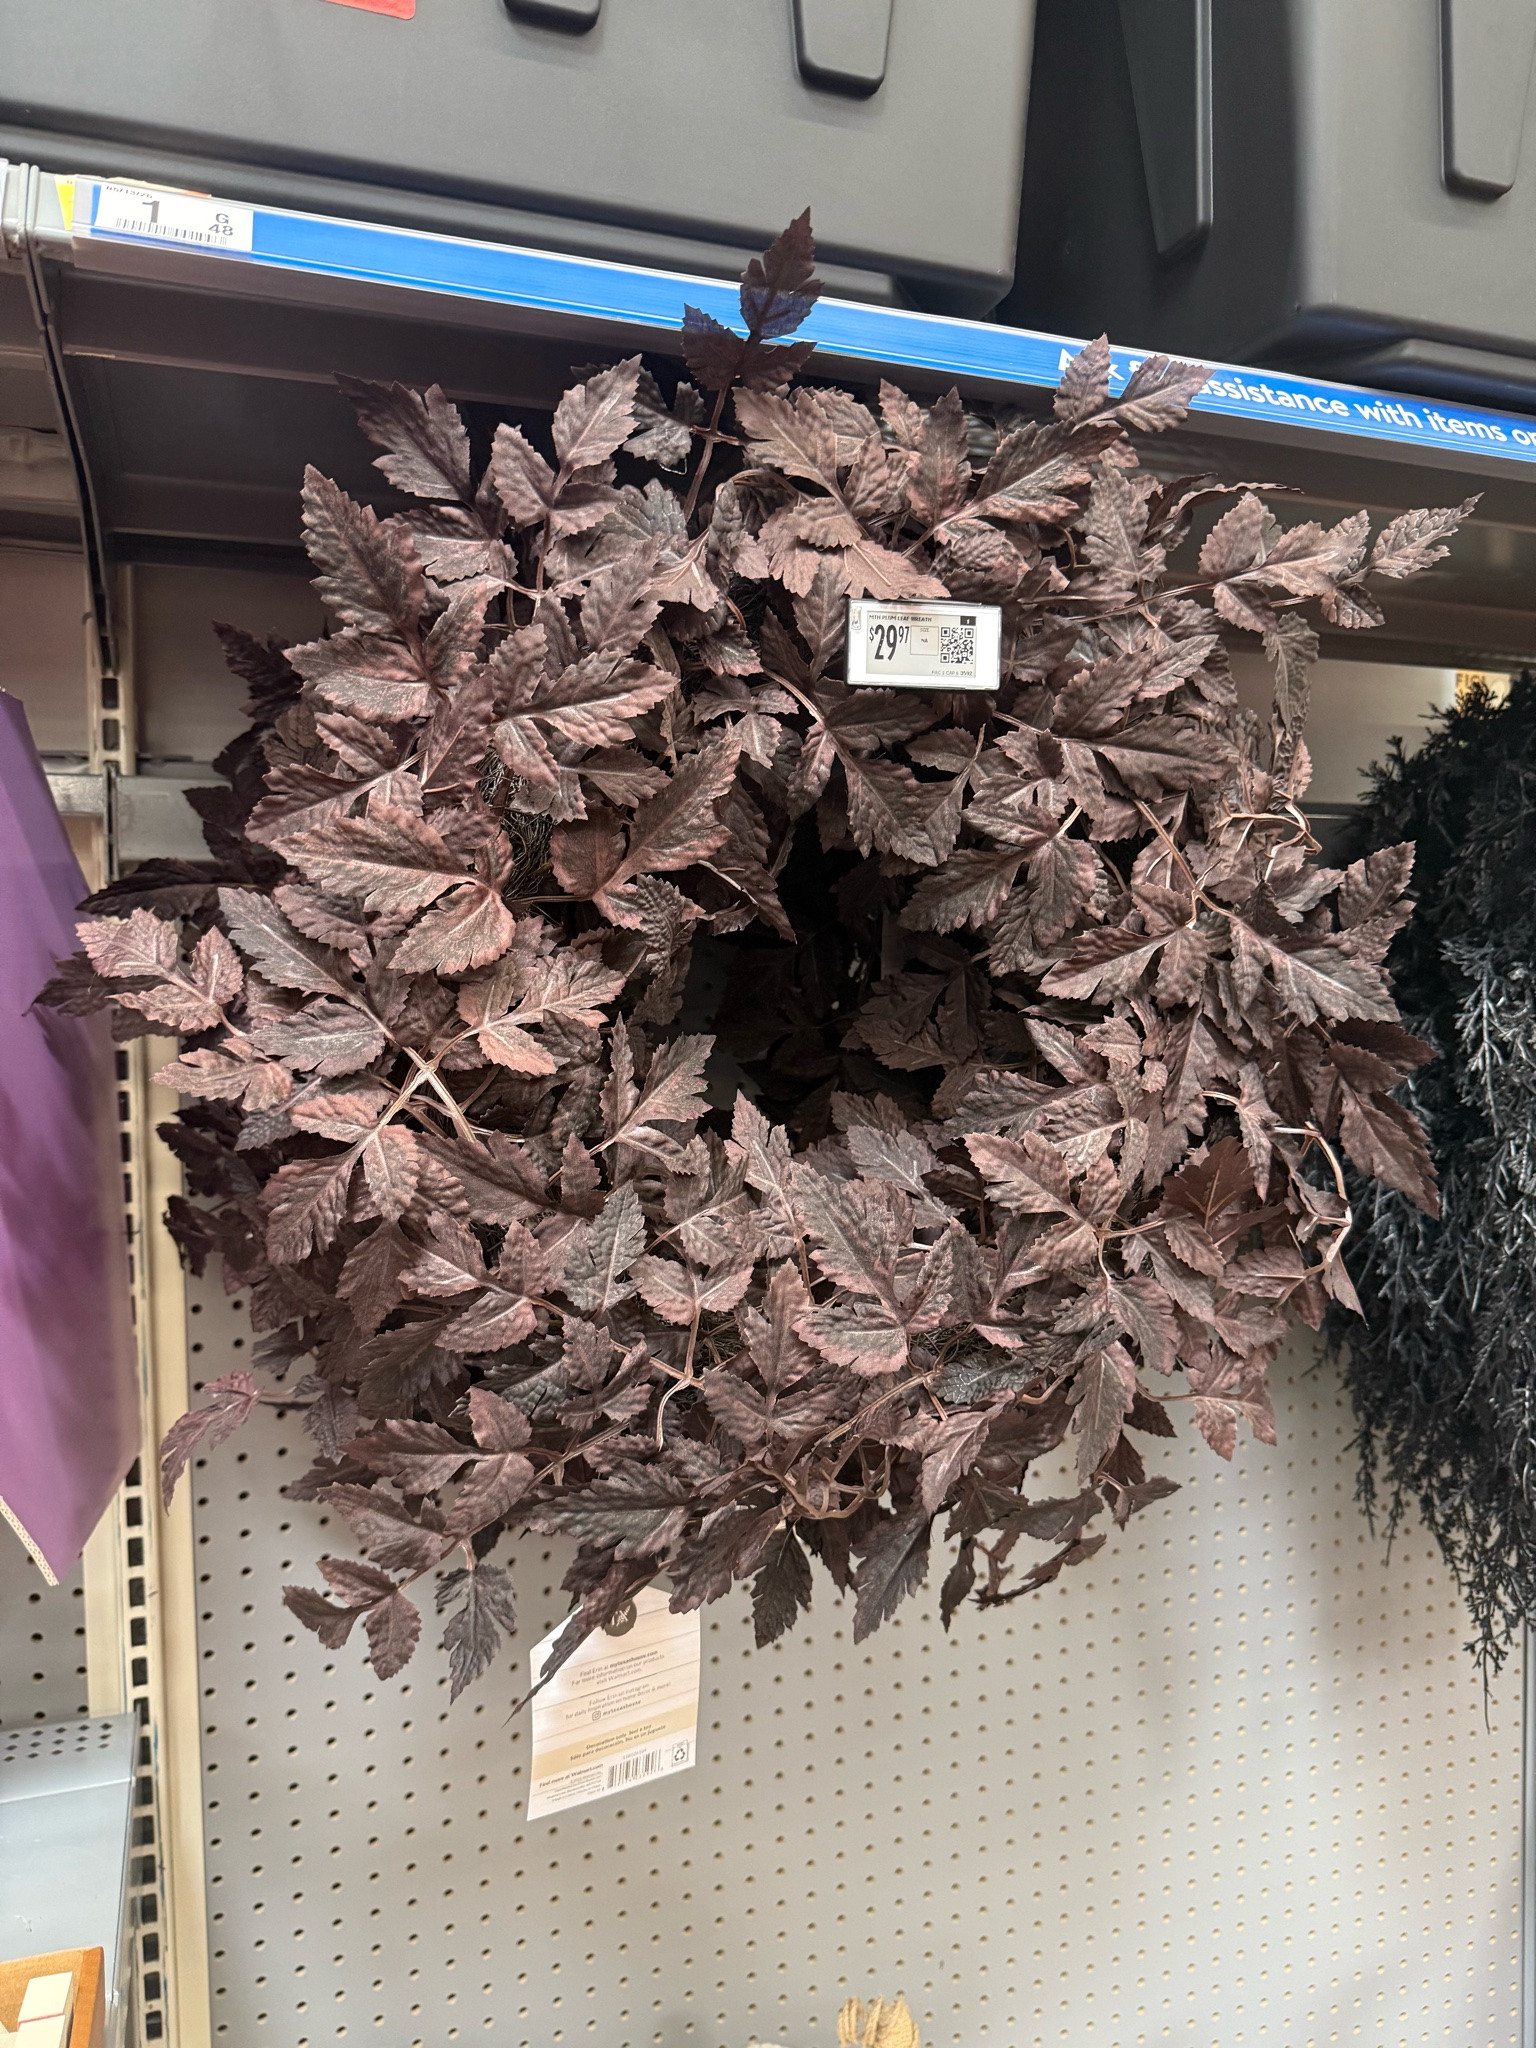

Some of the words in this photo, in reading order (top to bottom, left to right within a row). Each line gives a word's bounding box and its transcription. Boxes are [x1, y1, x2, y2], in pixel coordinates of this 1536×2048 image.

[142, 200, 160, 223] 1
[215, 213, 229, 224] G
[208, 223, 233, 236] 48
[1353, 400, 1423, 429] with
[1422, 407, 1508, 442] items
